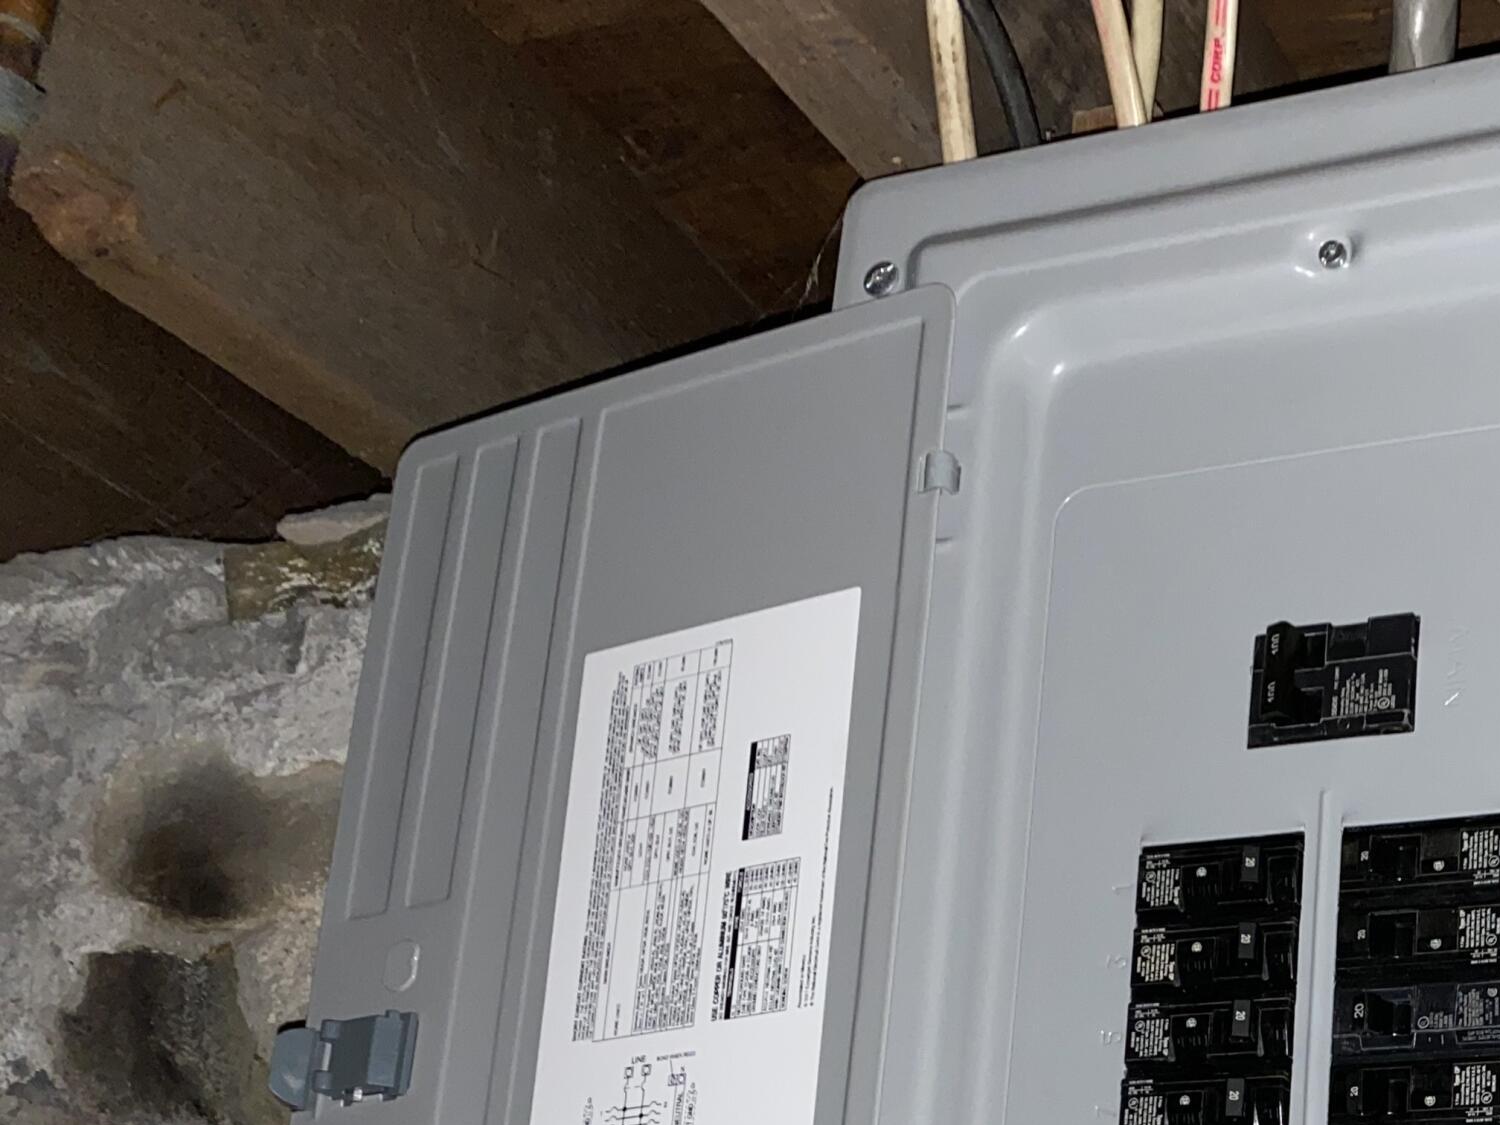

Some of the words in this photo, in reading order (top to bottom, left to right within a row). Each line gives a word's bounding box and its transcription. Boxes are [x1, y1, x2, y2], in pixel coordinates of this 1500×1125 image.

[1360, 849, 1370, 862] 20
[1245, 856, 1256, 868] 20
[1240, 933, 1251, 945] 20
[1356, 928, 1366, 940] 20
[1235, 1010, 1246, 1021] 20
[1354, 1003, 1366, 1019] 20
[1229, 1090, 1240, 1101] 20
[1350, 1086, 1360, 1097] 20
